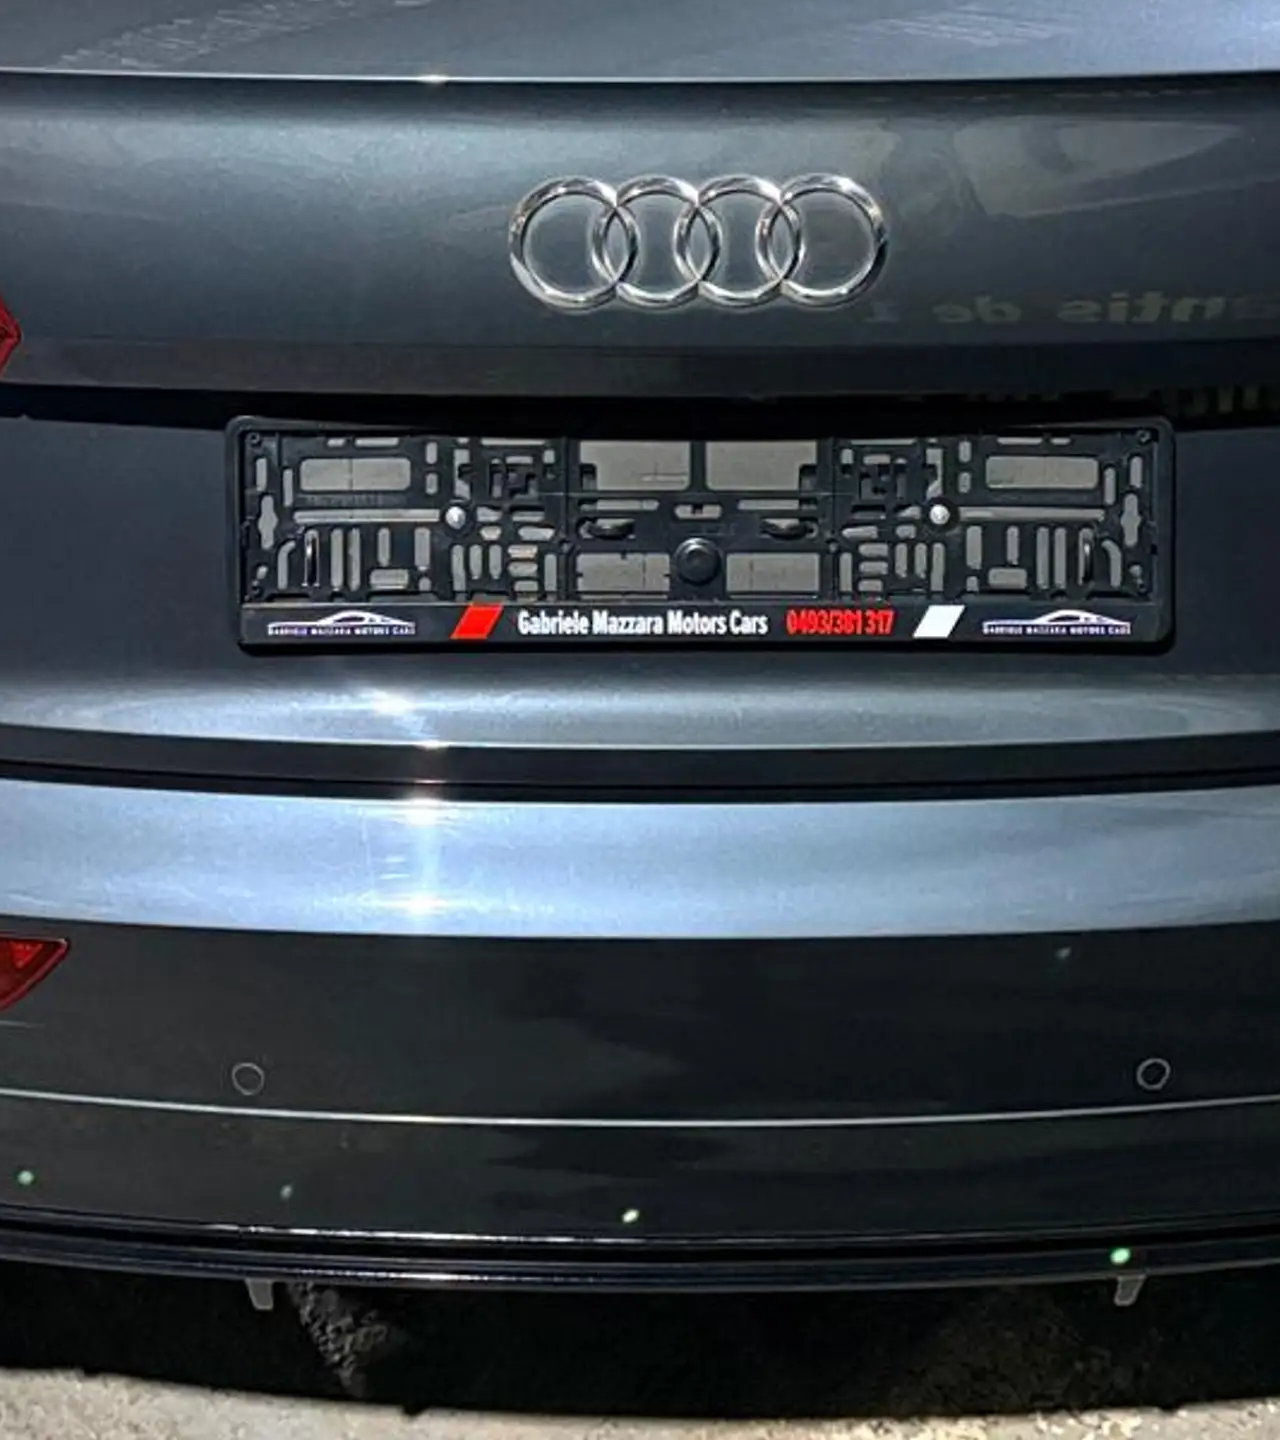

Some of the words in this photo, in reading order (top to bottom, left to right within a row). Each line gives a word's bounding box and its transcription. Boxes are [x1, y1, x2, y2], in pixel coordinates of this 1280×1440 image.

[518, 609, 589, 635] Gabriele
[592, 609, 664, 635] Mazzara
[667, 609, 728, 635] Motors
[729, 609, 769, 635] Cars
[786, 609, 863, 636] 0493/381
[864, 609, 897, 635] 317
